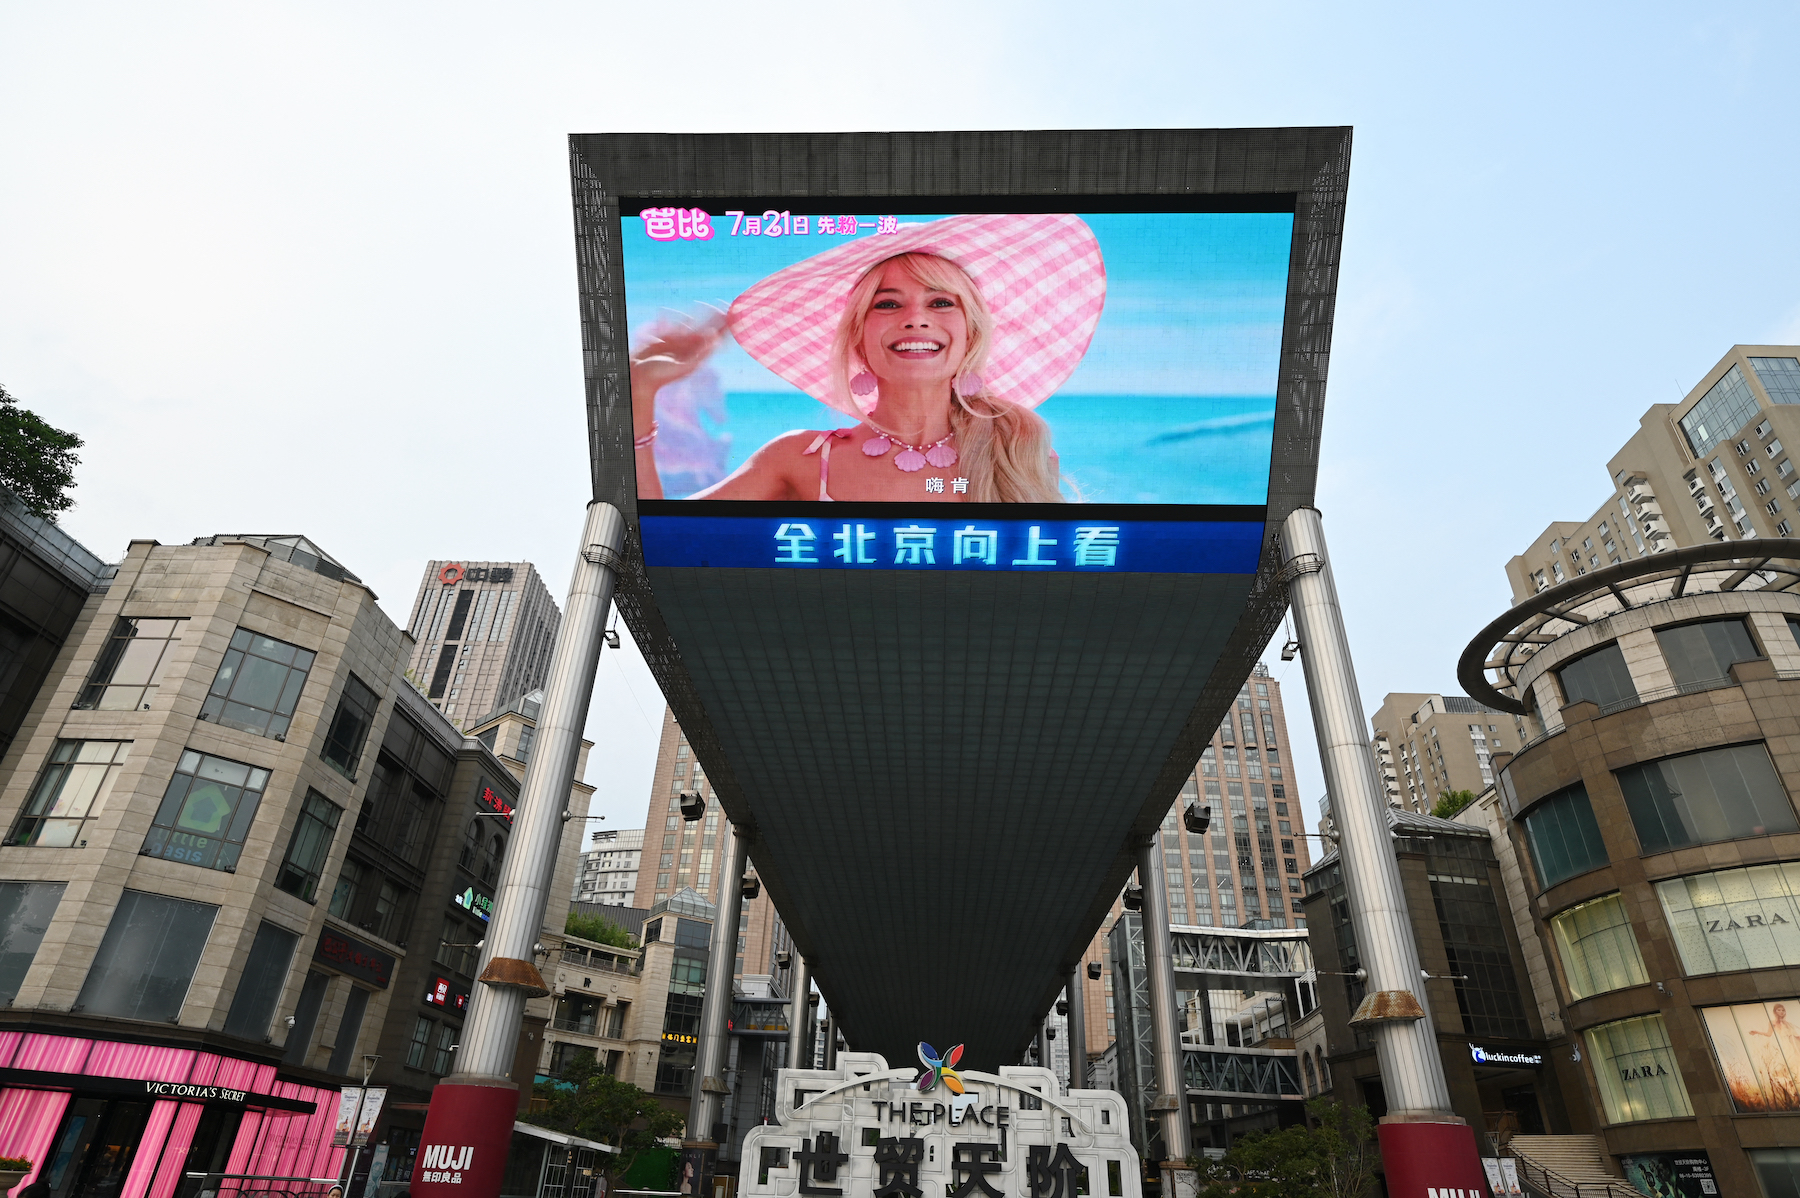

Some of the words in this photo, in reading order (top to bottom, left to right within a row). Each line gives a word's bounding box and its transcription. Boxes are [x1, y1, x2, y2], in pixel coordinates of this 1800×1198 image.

[640, 208, 714, 241] 芭比
[725, 211, 809, 237] 7月21日
[818, 215, 898, 236] 先粉一波
[774, 524, 1120, 567] 全北京向上看
[150, 843, 203, 863] oasis
[1707, 913, 1790, 933] ZARA
[1622, 1063, 1669, 1081] ZARA
[145, 1082, 217, 1099] VICTORIA'S
[219, 1086, 247, 1103] SECRET
[871, 1101, 923, 1124] THE
[934, 1101, 1010, 1129] PLACE
[422, 1144, 475, 1171] MUJI
[793, 1136, 1084, 1198] 世贸天阶
[422, 1170, 463, 1185] 無印良品
